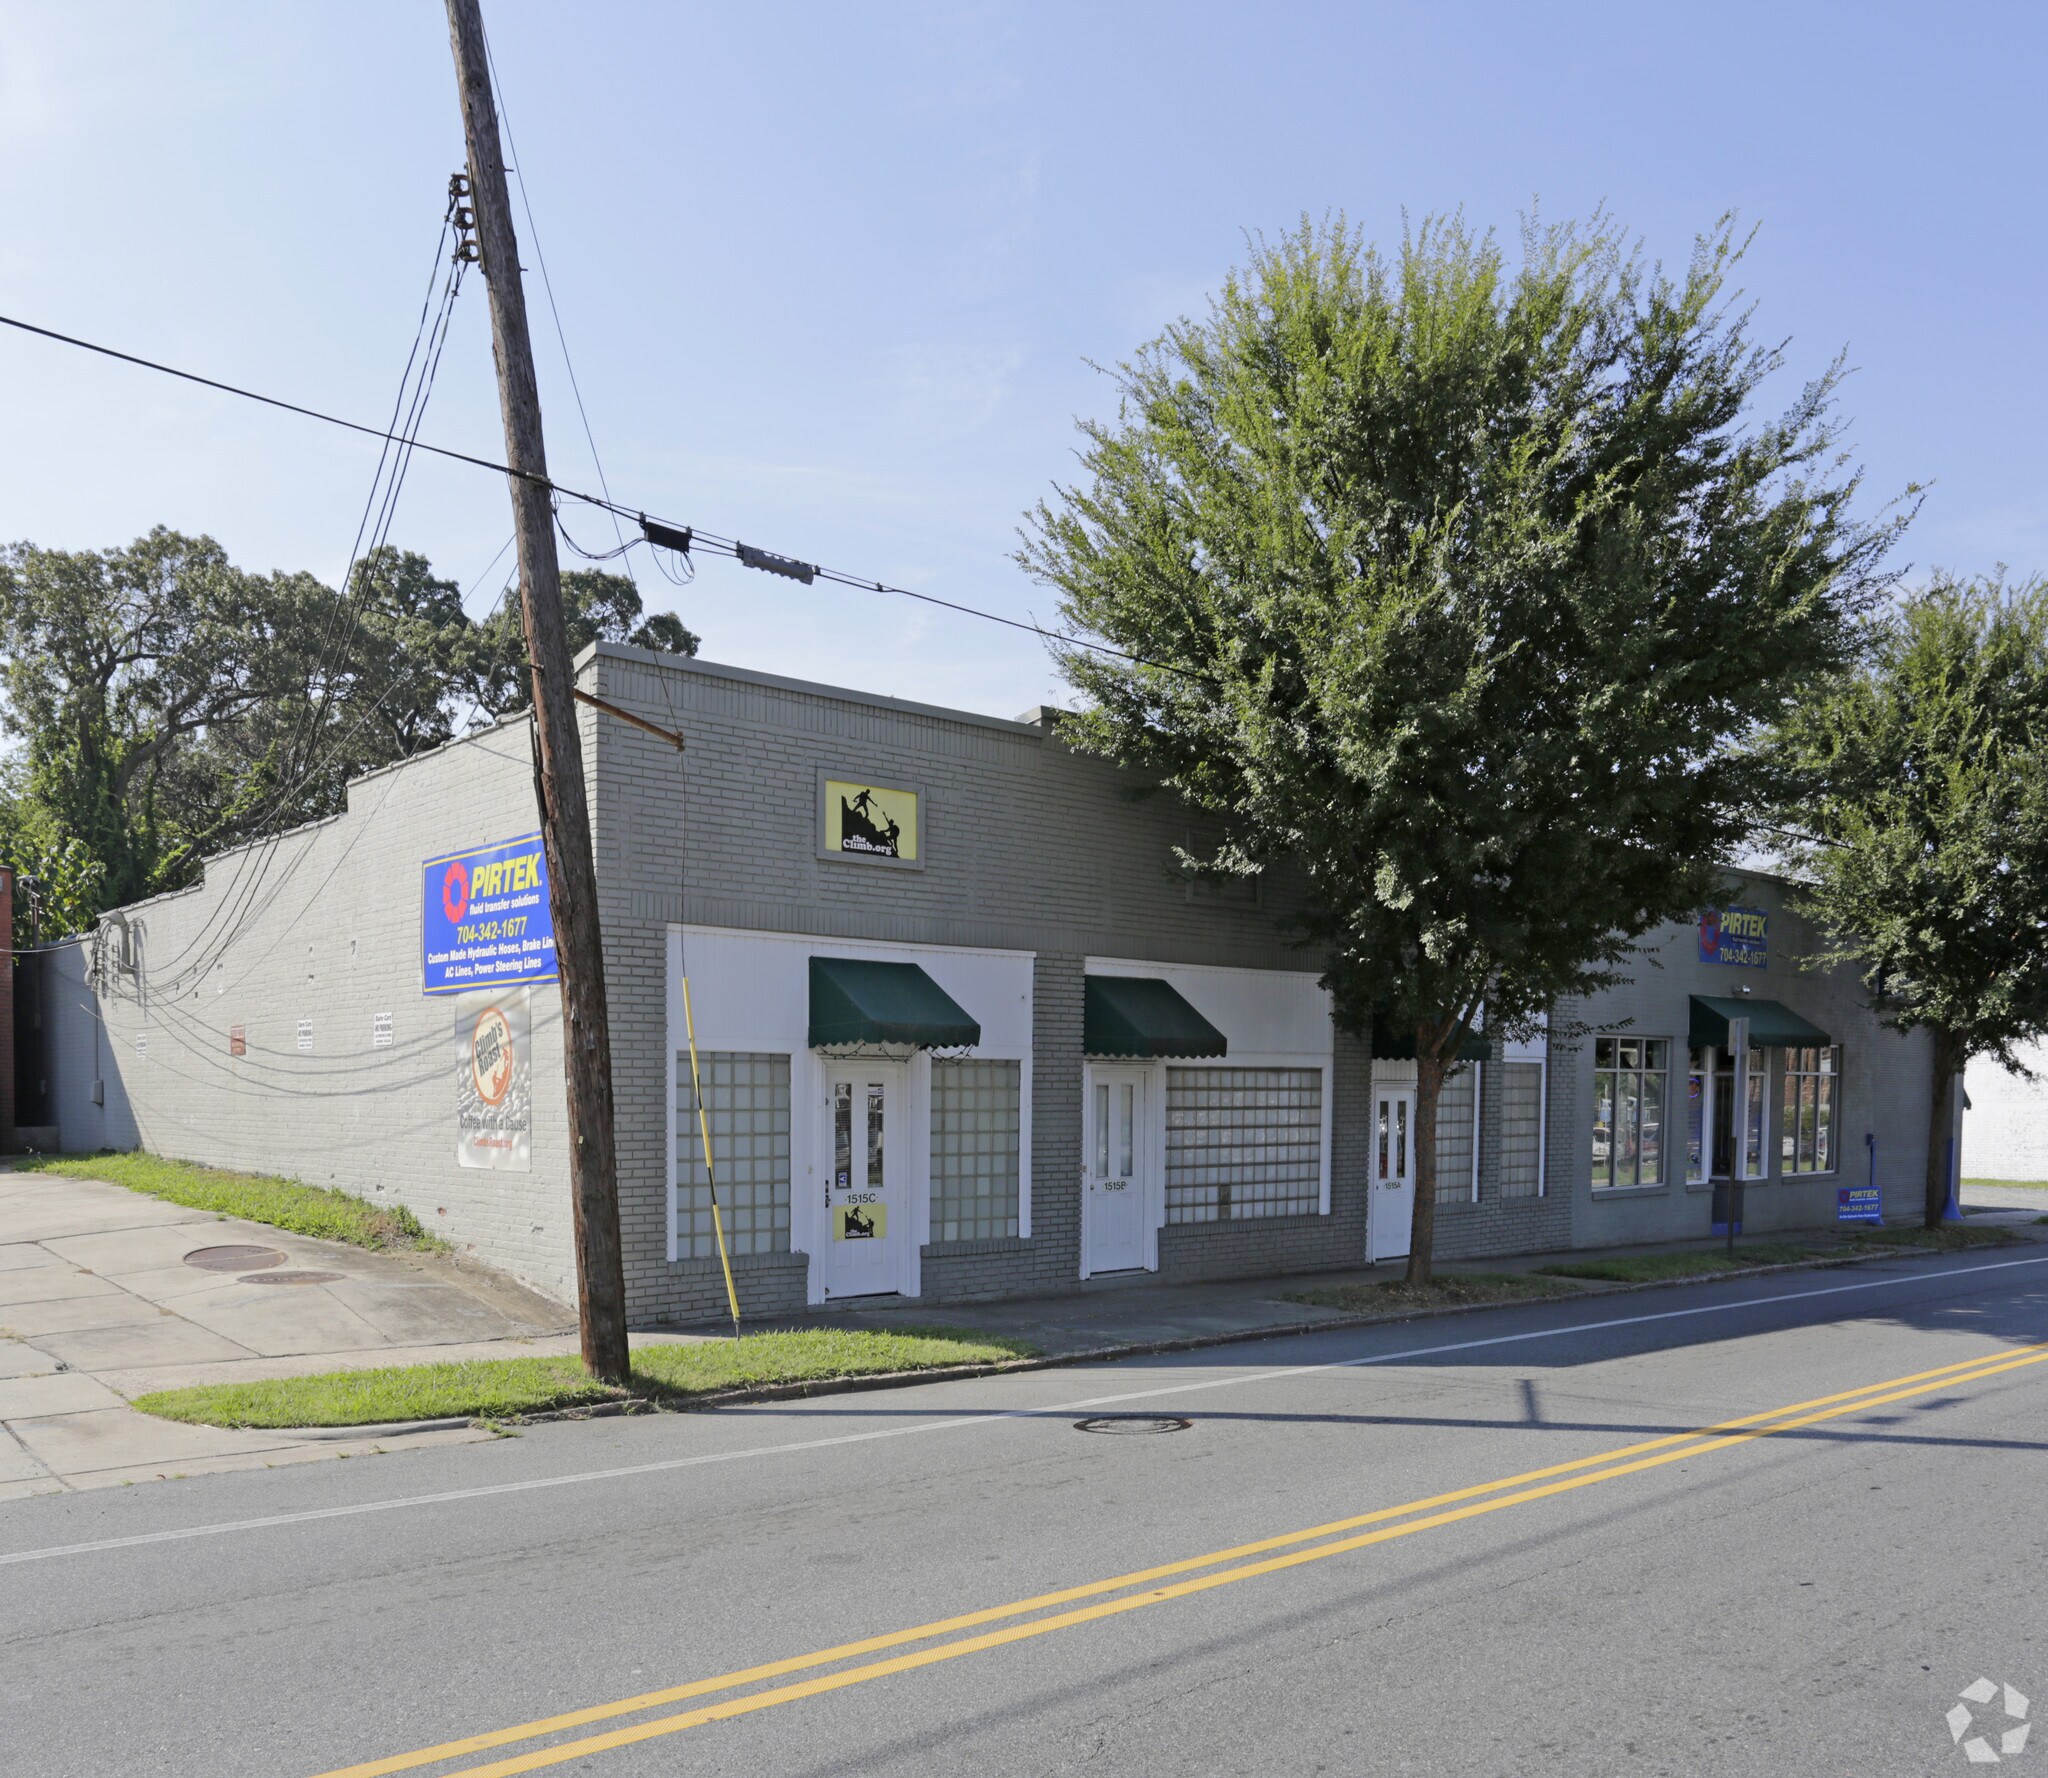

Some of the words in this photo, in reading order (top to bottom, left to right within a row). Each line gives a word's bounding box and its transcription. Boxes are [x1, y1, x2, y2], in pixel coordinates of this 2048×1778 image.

[843, 838, 892, 855] Climb.org
[852, 835, 867, 844] the
[470, 852, 542, 900] PIRTEK
[469, 902, 484, 916] fluid
[485, 898, 510, 914] transfer
[511, 894, 540, 909] solutions
[457, 916, 528, 945] 704-342-1677
[1720, 912, 1767, 938] PIRTEK
[428, 952, 449, 964] Custom
[450, 948, 467, 962] Made
[467, 945, 498, 961] Hydraulic
[498, 942, 521, 955] Hoses,
[522, 939, 541, 951] Brake
[1720, 947, 1767, 965] 704-342-1677
[445, 966, 454, 978] AC
[455, 964, 474, 977] Lines,
[474, 962, 495, 975] Power
[495, 959, 523, 973] Steering
[524, 957, 542, 969] Lines
[475, 1021, 503, 1059] Climb's
[478, 1042, 502, 1077] Roast
[460, 1115, 480, 1129] Coffee
[482, 1115, 498, 1130] with
[499, 1119, 504, 1131] a
[505, 1116, 527, 1132] Cause
[847, 1193, 876, 1204] 1515C
[1850, 1190, 1878, 1198] PIRTEK
